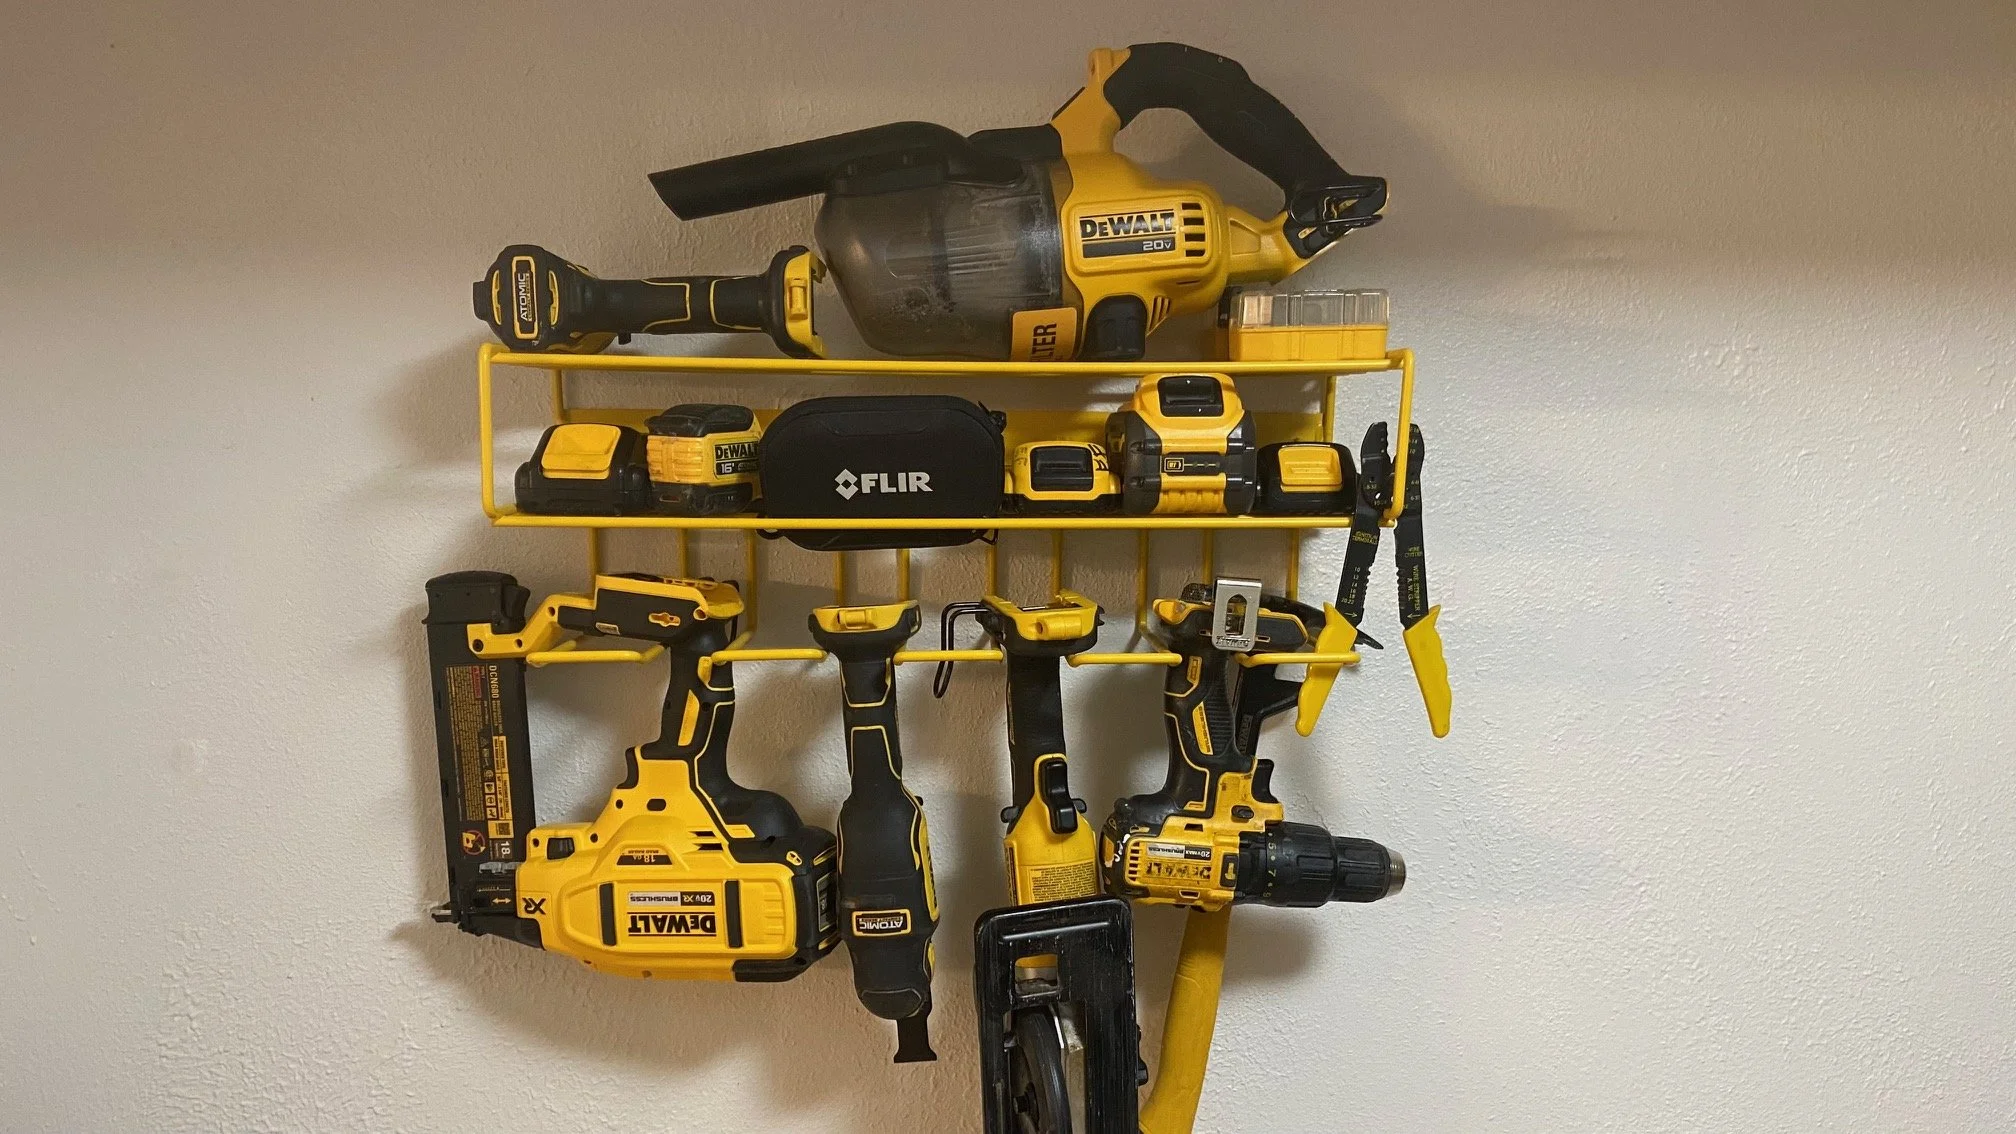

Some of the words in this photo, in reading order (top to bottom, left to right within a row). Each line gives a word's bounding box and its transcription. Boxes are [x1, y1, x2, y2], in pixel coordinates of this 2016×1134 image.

[518, 273, 528, 321] ATOMIC
[721, 462, 735, 474] 16'
[861, 471, 933, 494] FLIR
[489, 665, 499, 699] DCN680
[500, 840, 511, 855] 18
[1148, 846, 1184, 855] BRUSHLESS
[1268, 842, 1277, 850] 5
[644, 854, 656, 863] 18
[1268, 869, 1277, 877] 7
[682, 895, 694, 903] XR
[522, 897, 547, 915] XR
[859, 921, 903, 929] ATOMIC
